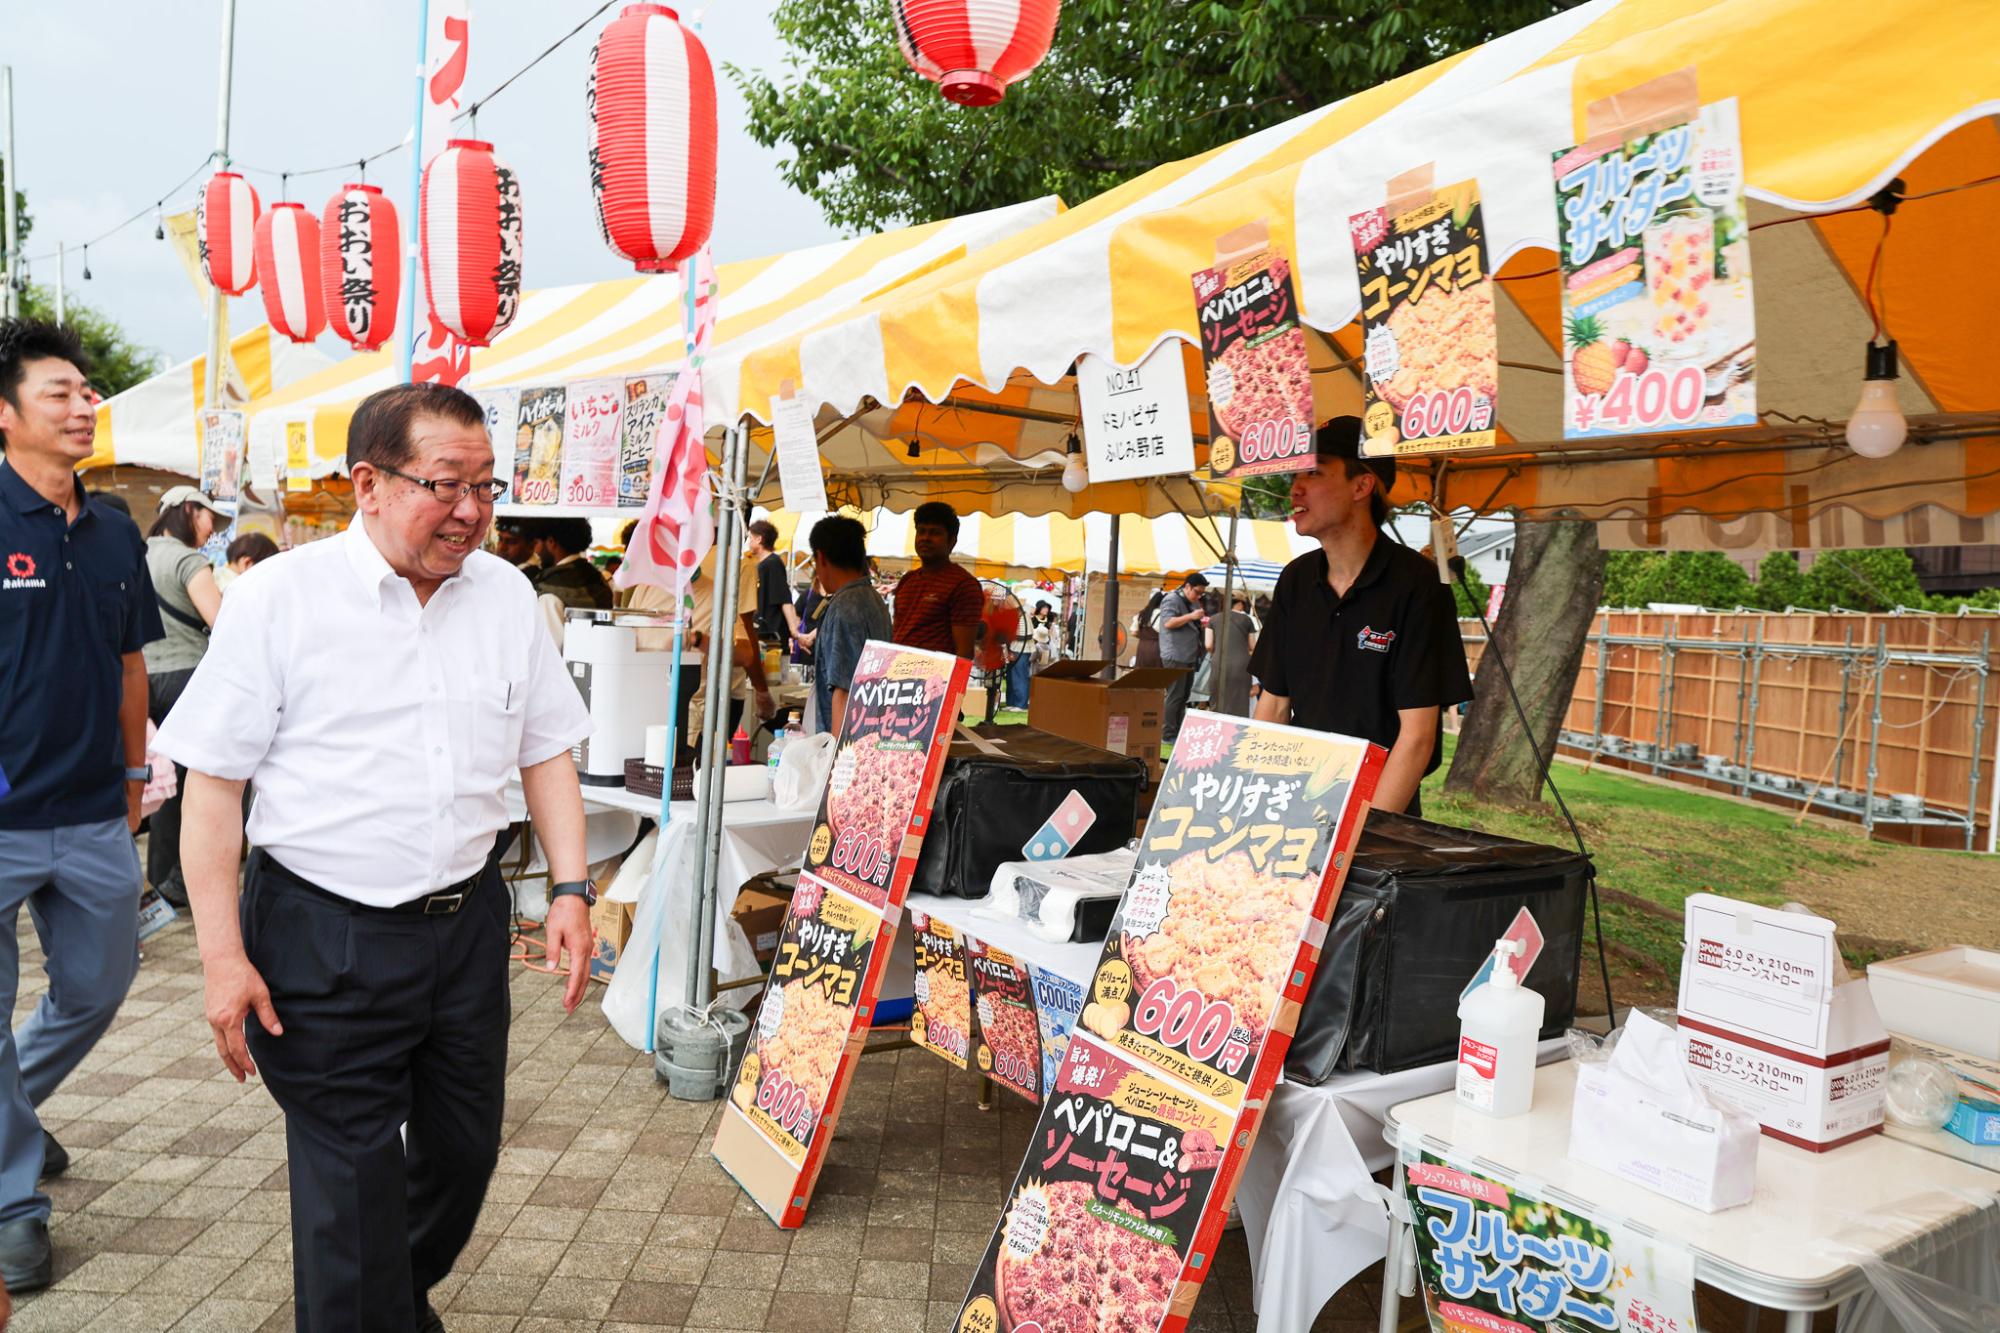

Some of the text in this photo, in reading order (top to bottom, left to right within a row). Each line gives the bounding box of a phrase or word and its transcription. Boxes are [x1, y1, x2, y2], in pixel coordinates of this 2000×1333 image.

[1560, 129, 1690, 219] フルーツ
[1568, 173, 1693, 263] サイダー
[492, 166, 522, 327] おおい祭り
[1375, 218, 1452, 275] やりすぎ
[338, 201, 378, 333] おおい祭り
[1361, 245, 1483, 320] コーンマヨ
[1201, 276, 1274, 323] ペパロニ&
[1205, 288, 1289, 352] ソーセージ
[1106, 371, 1140, 392] NO.41
[519, 395, 565, 424] ハイボール
[571, 393, 615, 420] いちご
[626, 392, 662, 418] スリランカ
[1402, 386, 1492, 440] 600円
[1575, 367, 1704, 430] ¥400
[573, 422, 600, 440] ミルク
[627, 413, 655, 434] アイス
[629, 431, 650, 447] ミルク
[624, 446, 652, 462] コーヒー
[1106, 435, 1164, 462] ふじみ野店
[854, 681, 923, 707] ペパロニ&
[849, 706, 932, 738] ソーセージ
[1183, 721, 1223, 743] やみつき
[1187, 736, 1224, 760] 注意!
[1249, 741, 1305, 753] コーンたっぷり!
[1190, 772, 1302, 821] やりすぎ
[1149, 805, 1318, 875] コーンマヨ
[832, 827, 890, 886] 600円
[798, 919, 851, 963] やりすぎ
[922, 932, 953, 955] やりすぎ
[1699, 942, 1723, 955] SPOON
[775, 942, 858, 1006] コーンマヨ
[915, 946, 964, 981] コーンマヨ
[1698, 953, 1722, 967] STRAW
[1723, 959, 1800, 985] スプーンストロー
[1725, 947, 1743, 960] 6.0
[1769, 957, 1815, 978] 210mm
[1099, 971, 1128, 985] ボリューム
[1102, 986, 1125, 1001] 満点!
[1038, 981, 1083, 1015] COOLis
[1134, 977, 1250, 1076] 600円
[1231, 1026, 1251, 1042] 税込
[1069, 1045, 1090, 1064] 旨み
[1118, 1033, 1219, 1088] 焼きたてアツアツをご提供!
[1688, 1054, 1712, 1068] STRAW
[1690, 1043, 1713, 1057] SPOON
[1069, 1065, 1106, 1089] 爆発!
[1713, 1060, 1789, 1092] スプーンストロー
[1715, 1049, 1733, 1061] 6.0
[1758, 1062, 1804, 1085] 210mm
[758, 1068, 811, 1141] 600円
[1124, 1095, 1206, 1128] ペパロニの最強コンビ!
[1127, 1082, 1199, 1112] ジューシーソーセージと
[1054, 1097, 1178, 1169] ペパロニ&
[1042, 1129, 1191, 1219] ソーセージ
[1417, 1186, 1615, 1292] フルーツ
[1432, 1246, 1619, 1330] サイダー
[970, 1309, 992, 1329] みんな
[1631, 1297, 1677, 1331] ごろっと
